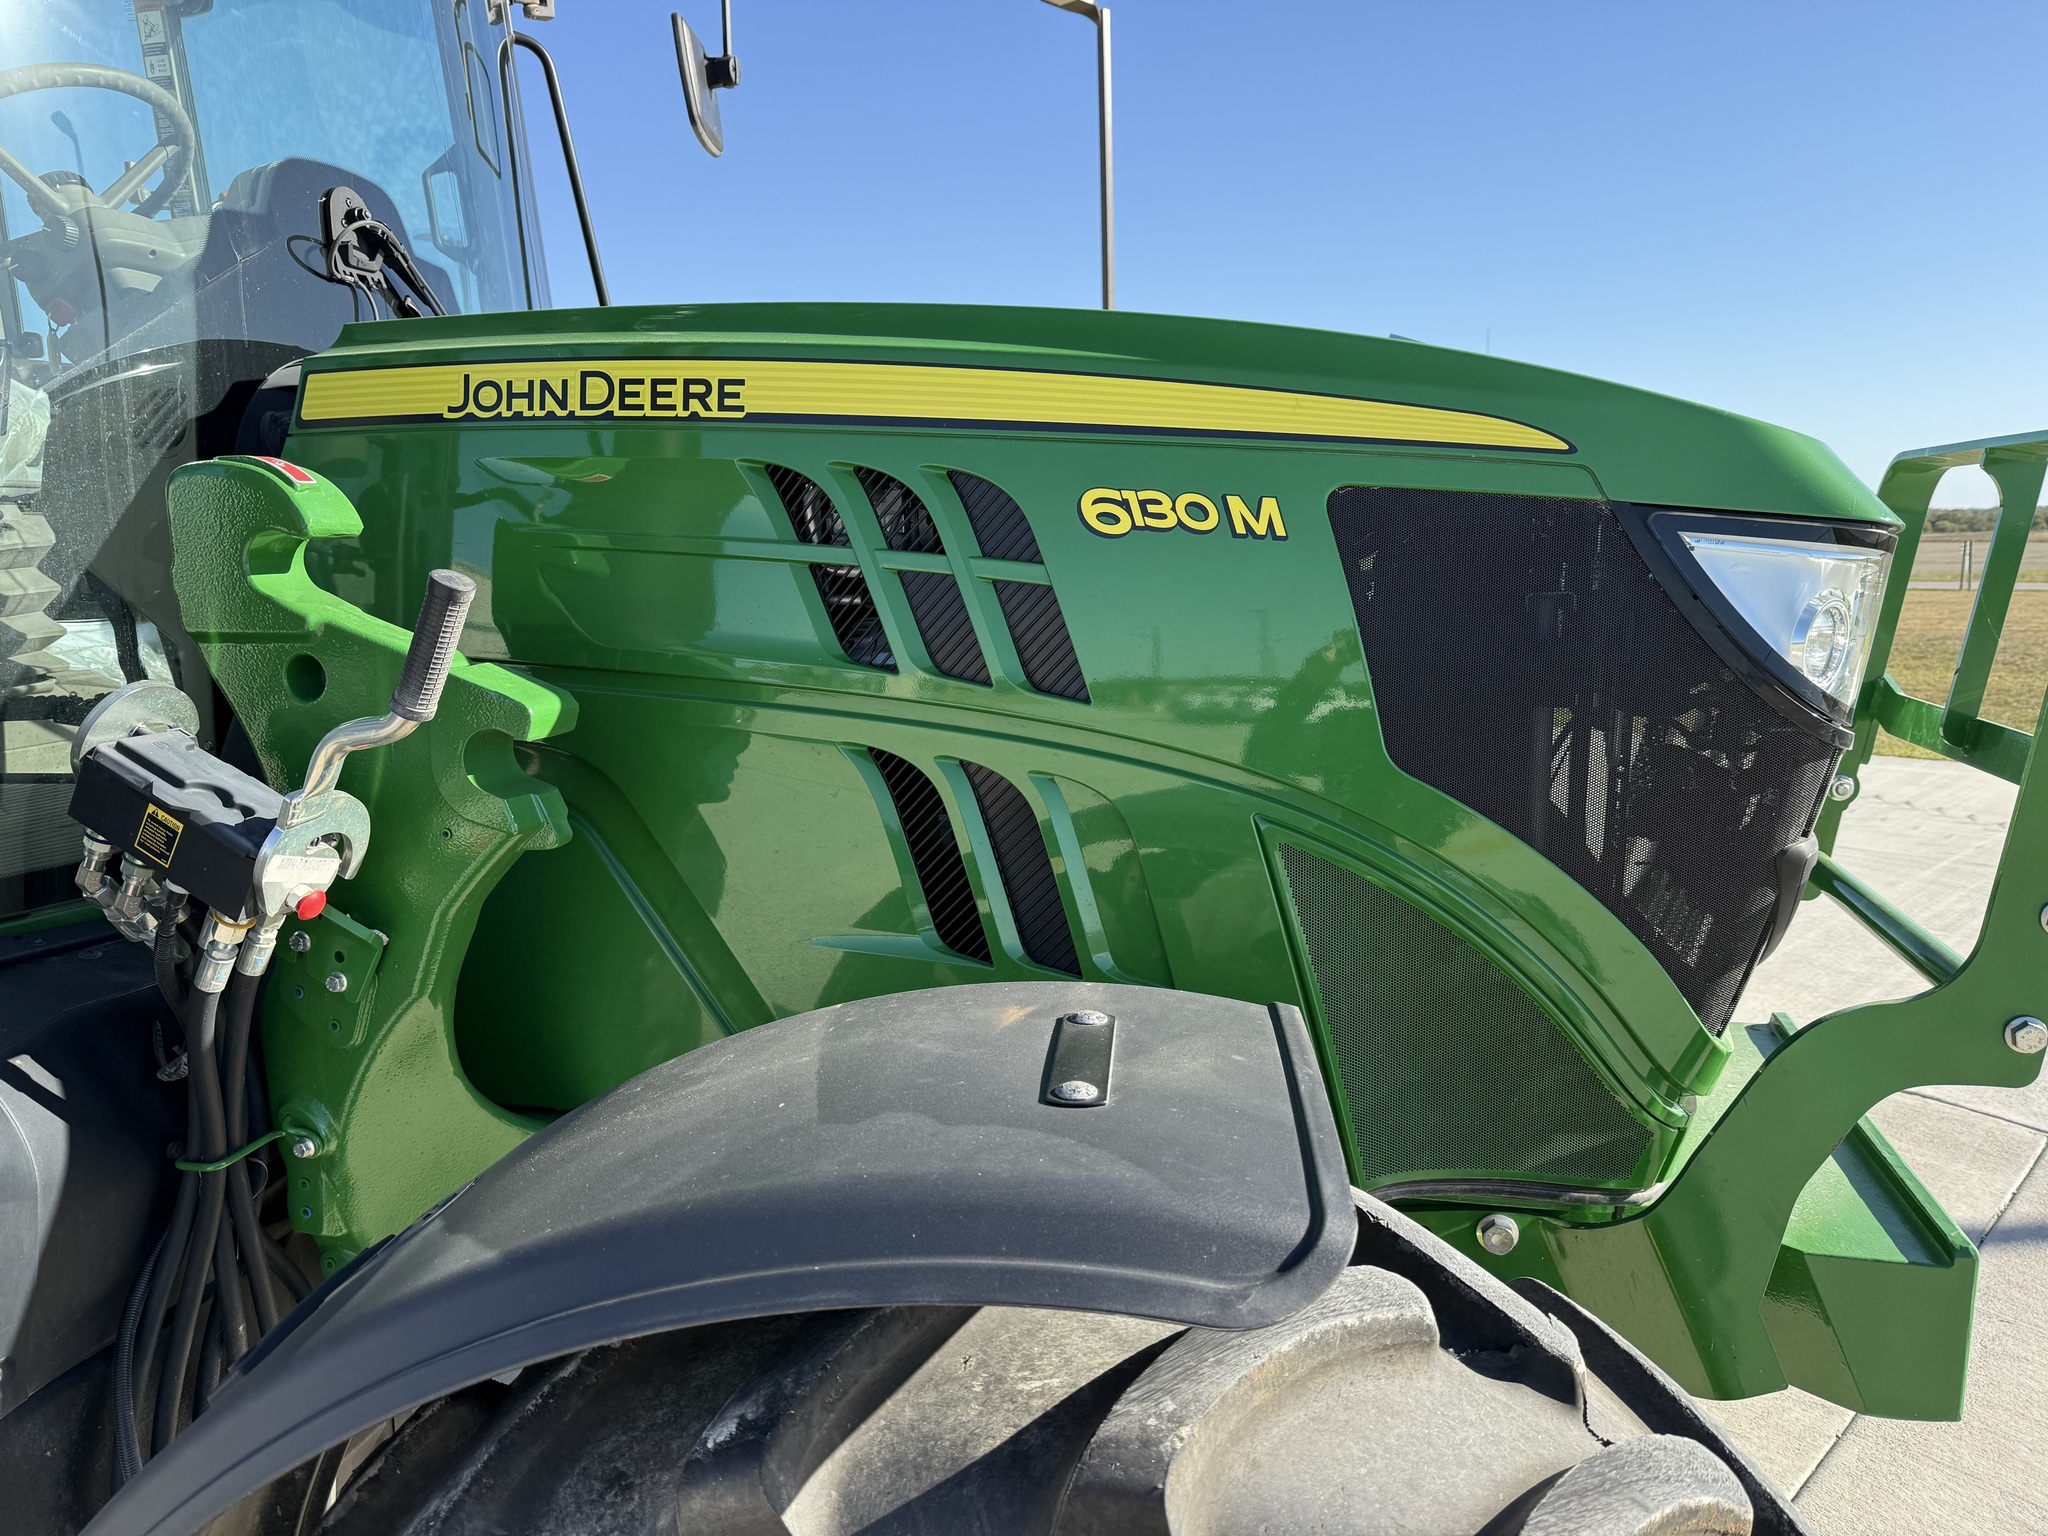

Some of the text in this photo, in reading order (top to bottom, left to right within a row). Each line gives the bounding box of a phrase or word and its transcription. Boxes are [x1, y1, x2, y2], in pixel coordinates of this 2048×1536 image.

[445, 369, 748, 415] JOHN DEERE
[1077, 487, 1289, 541] 6130 M
[160, 814, 180, 831] CAUTION
